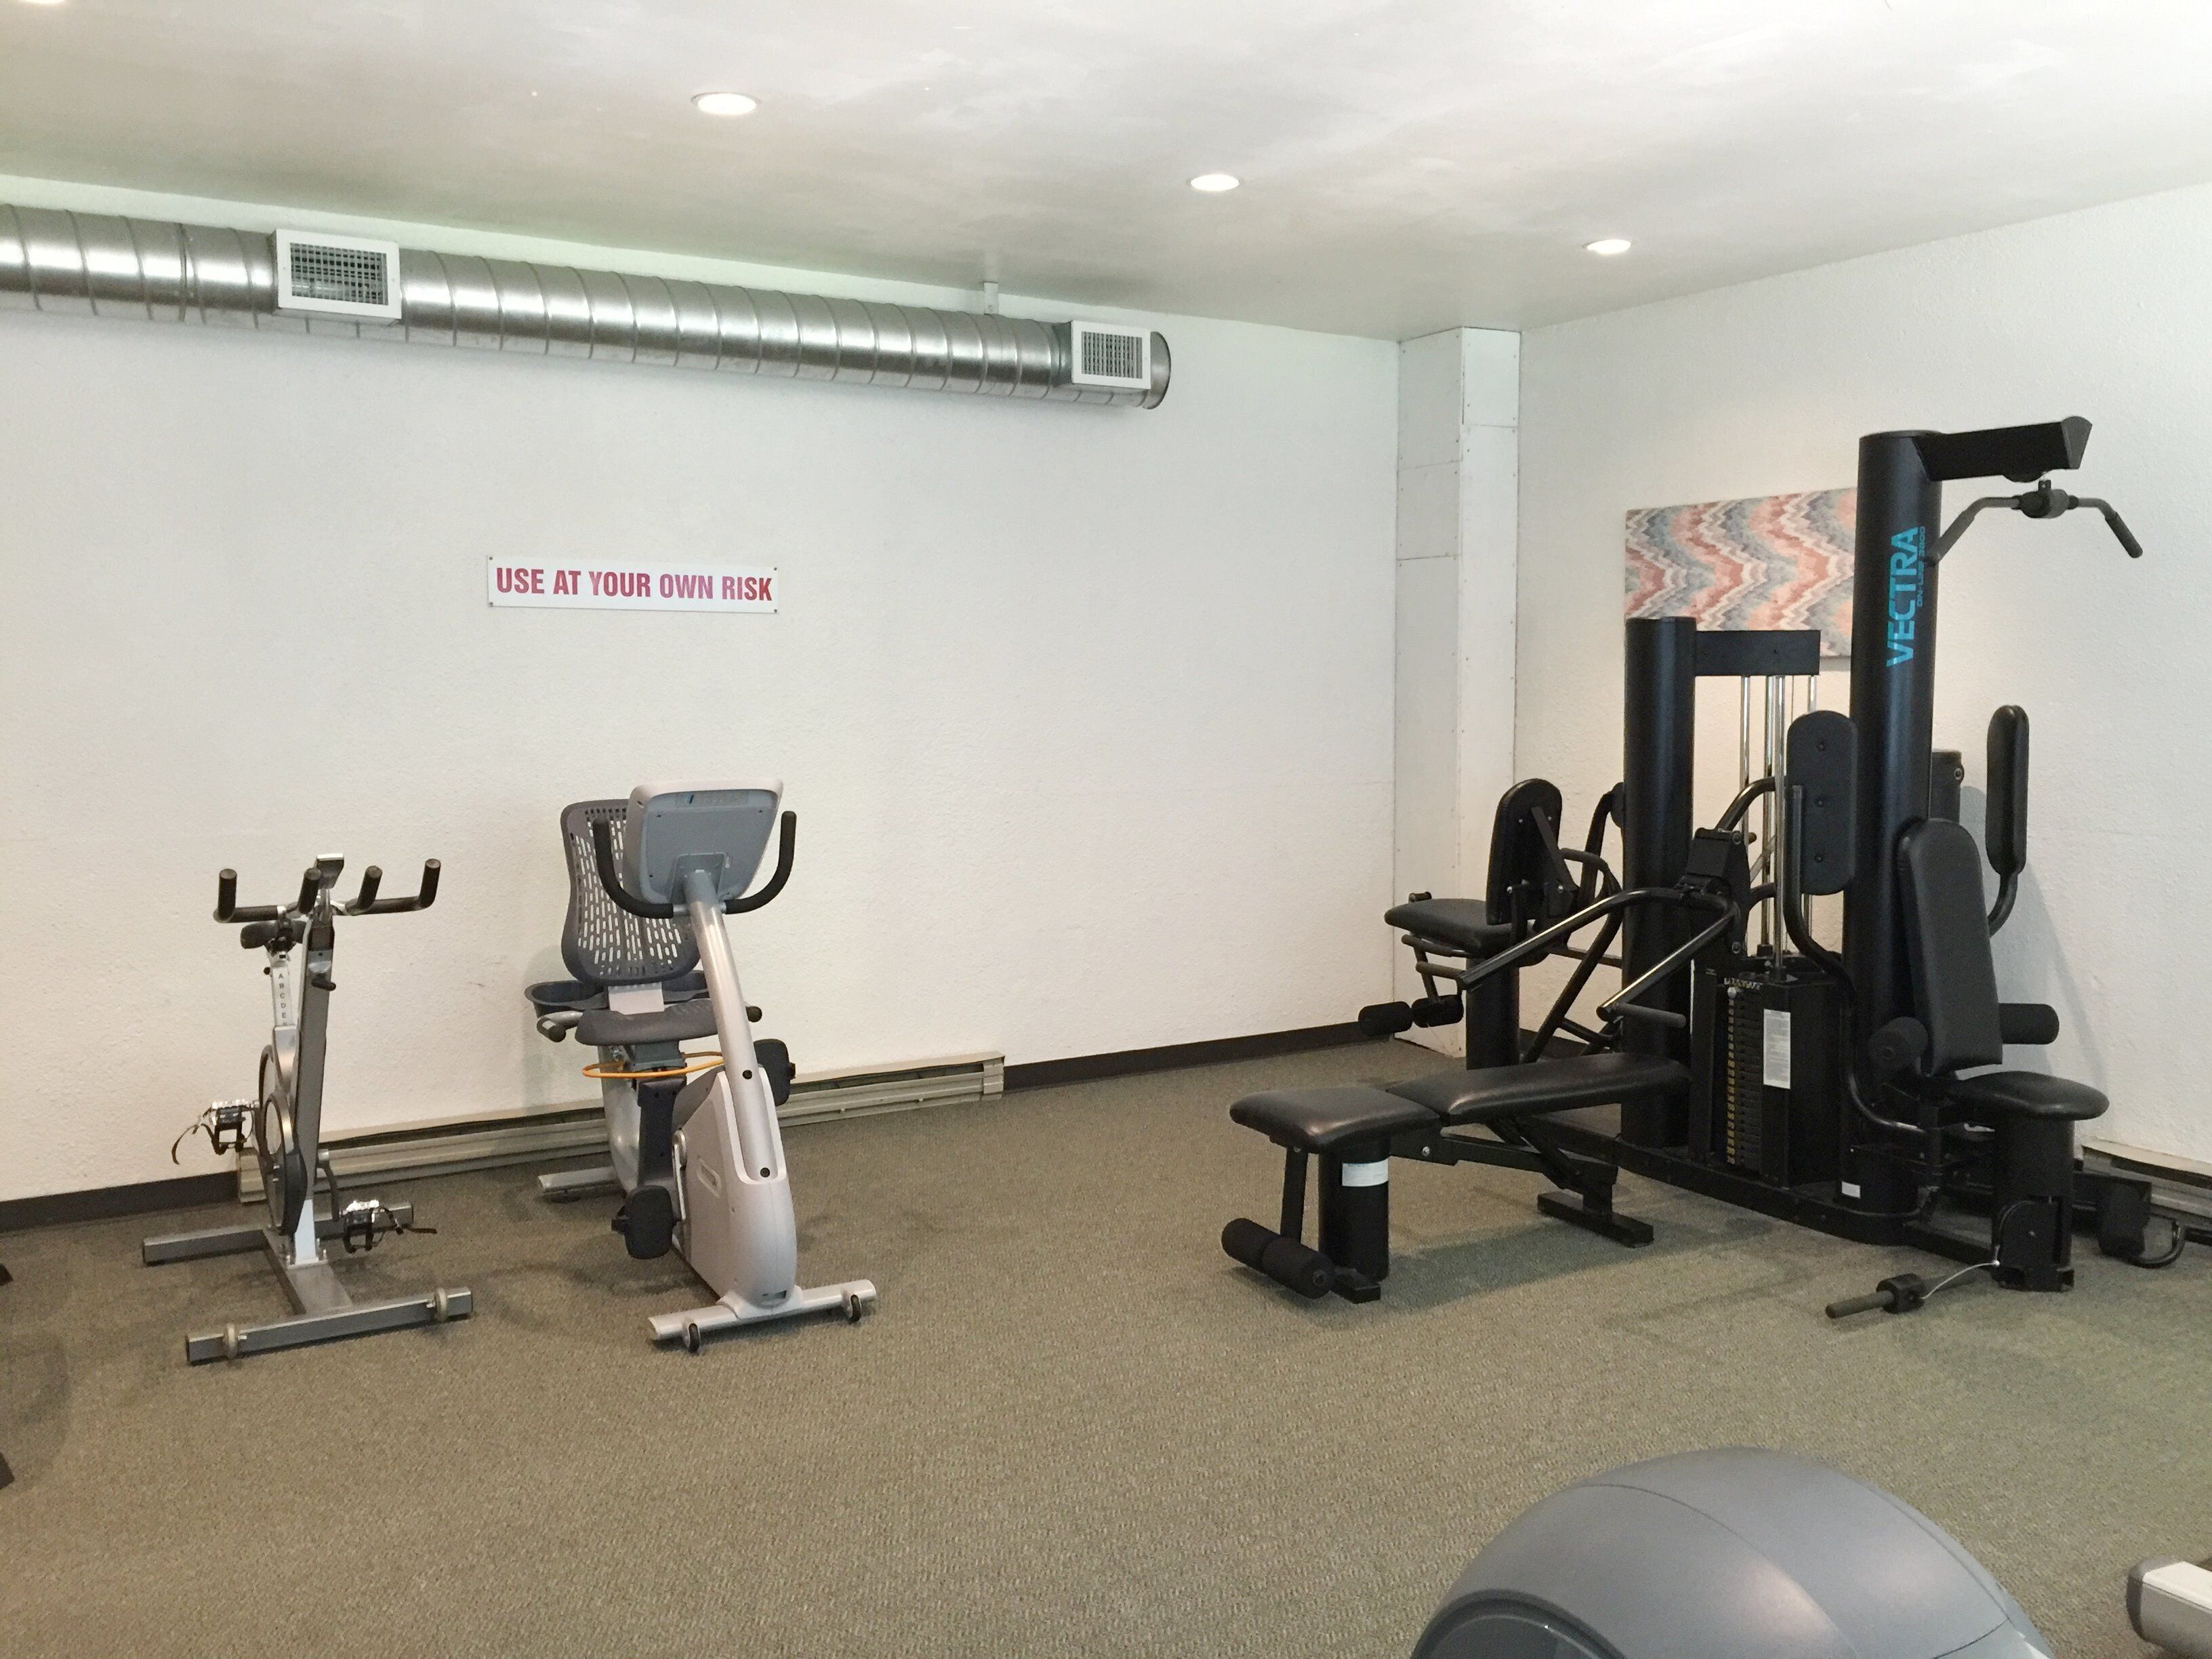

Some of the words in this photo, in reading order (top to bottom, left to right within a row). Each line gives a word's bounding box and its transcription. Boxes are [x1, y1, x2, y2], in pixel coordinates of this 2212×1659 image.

[496, 567, 545, 594] USE
[552, 570, 581, 596] AT
[588, 571, 651, 598] YOUR
[659, 573, 714, 599] OWN
[722, 576, 773, 602] RISK
[1886, 527, 1919, 668] VECTRA
